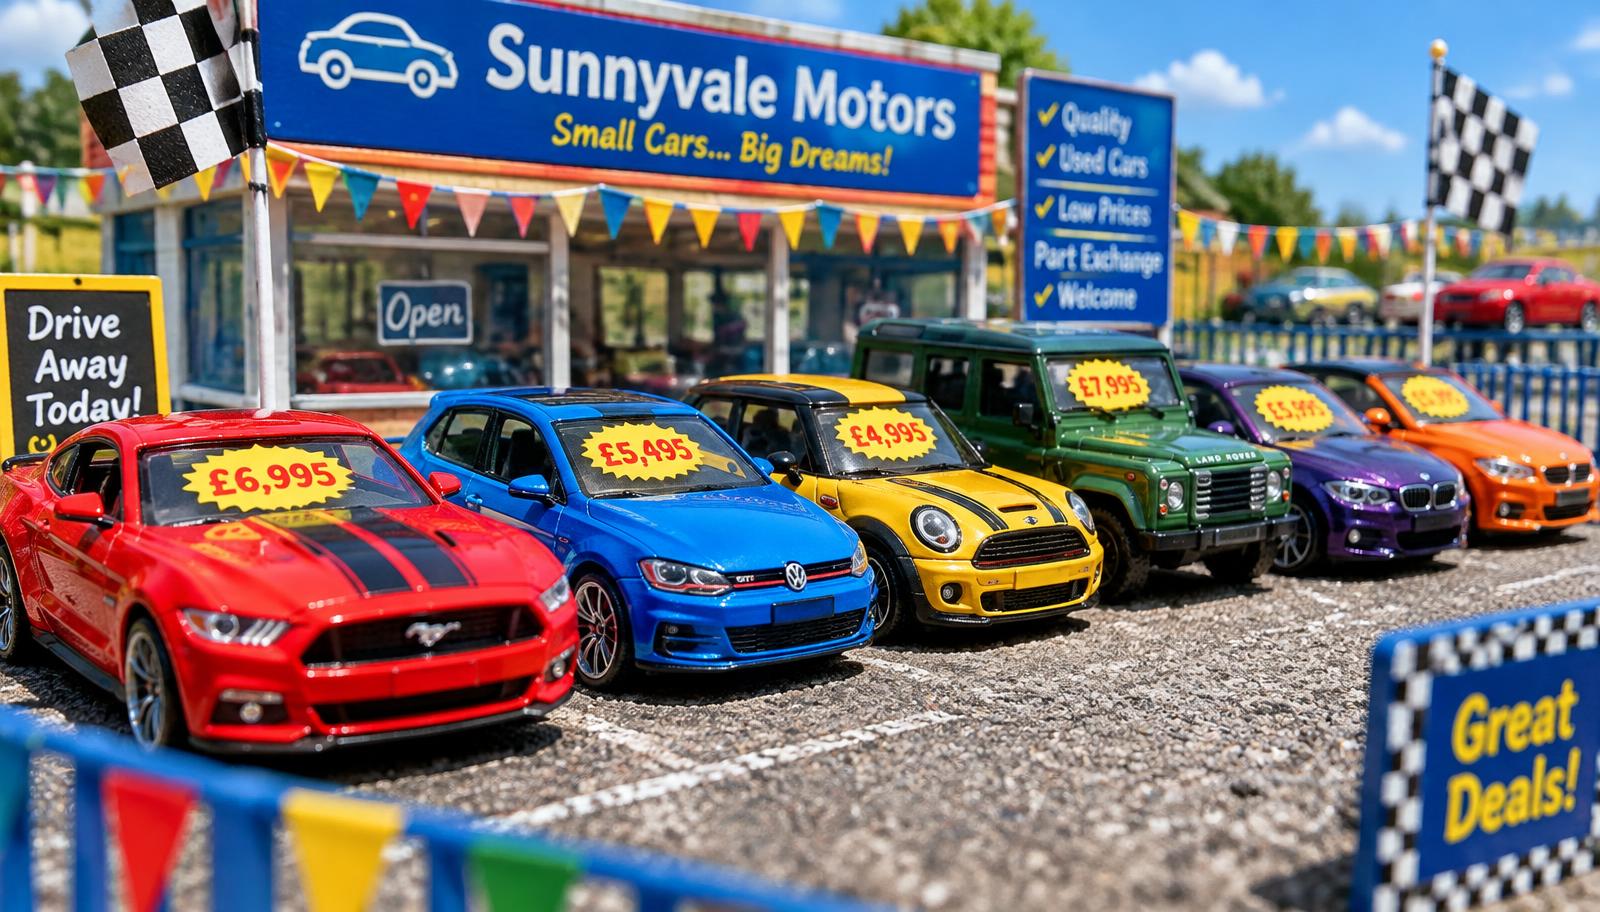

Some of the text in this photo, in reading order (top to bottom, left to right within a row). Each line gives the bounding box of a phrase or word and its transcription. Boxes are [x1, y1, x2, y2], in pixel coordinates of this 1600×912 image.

[486, 23, 957, 140] Sunnyvale Motors
[1062, 101, 1132, 145] Quality
[551, 112, 893, 175] Small Cars... Big Dreams!
[1059, 143, 1149, 179] Used Cars
[1058, 194, 1151, 227] Low Prices
[1034, 240, 1163, 279] Part Exchange
[385, 291, 465, 337] Open
[1057, 281, 1137, 310] Welcome
[27, 305, 121, 341] Drive
[35, 348, 128, 389] Away
[1078, 374, 1141, 399] £7,995
[26, 386, 142, 427] Today!
[598, 437, 694, 467] £5,495
[850, 421, 928, 449] £4,995
[1195, 453, 1222, 465] LAND
[208, 461, 337, 498] £6,995
[1452, 678, 1580, 764] Great
[1444, 746, 1582, 844] Deals!
